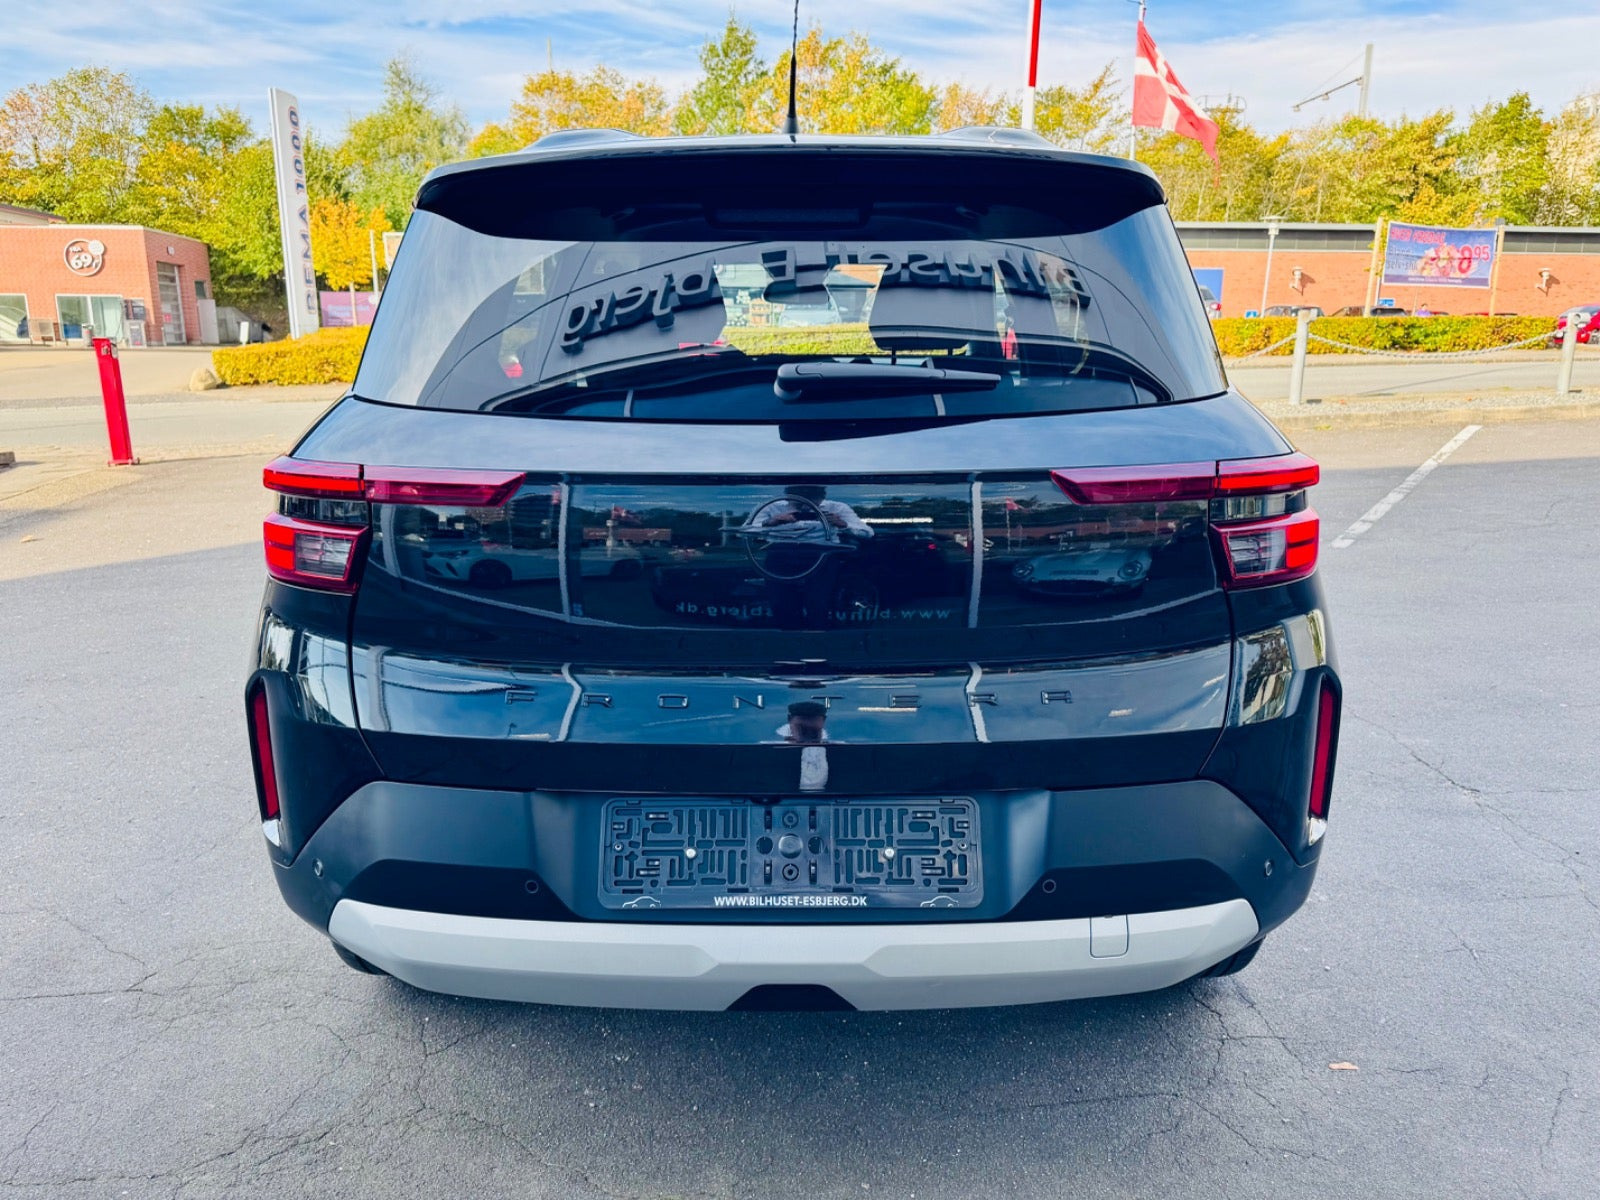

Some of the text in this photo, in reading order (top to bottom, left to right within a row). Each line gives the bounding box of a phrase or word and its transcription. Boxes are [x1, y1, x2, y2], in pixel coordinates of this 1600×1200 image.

[288, 105, 316, 314] REMA 1000
[506, 689, 1073, 709] FRONTERA
[714, 896, 867, 907] WWW.BILHUSET-ESBJERG.DK
